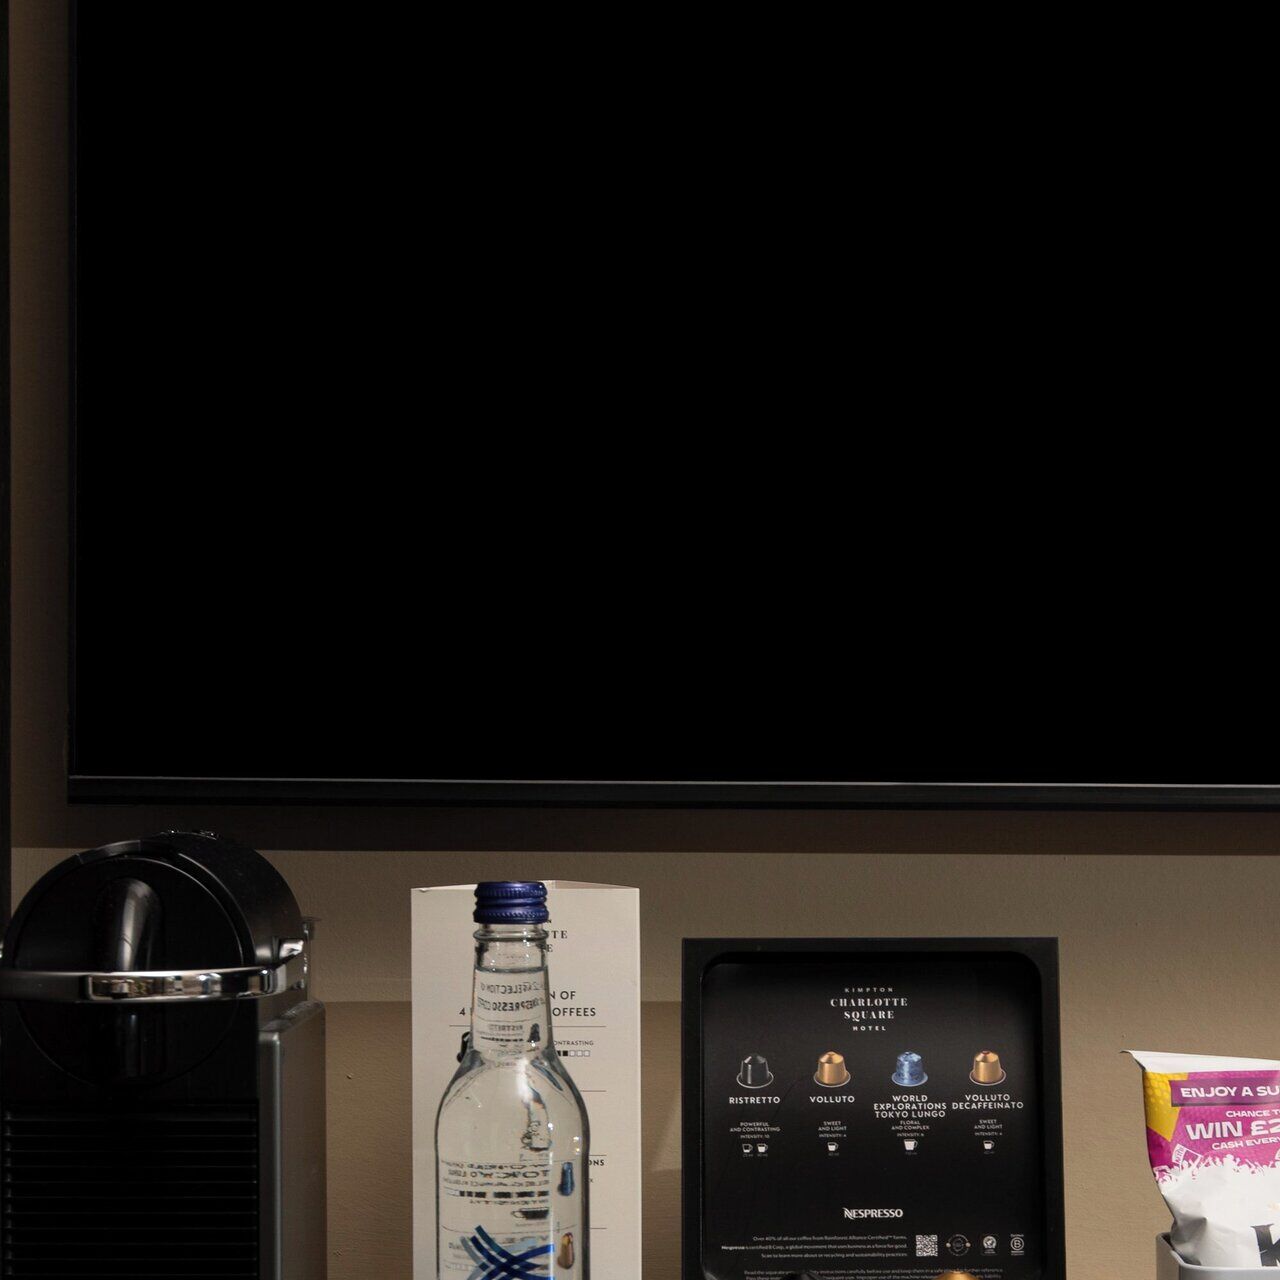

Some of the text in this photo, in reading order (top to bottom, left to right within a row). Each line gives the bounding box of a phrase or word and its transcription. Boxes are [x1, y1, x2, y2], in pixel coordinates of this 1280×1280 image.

[560, 991, 576, 1000] OF
[830, 998, 908, 1007] CHARLOTTE
[459, 1007, 596, 1017] 4 OFFEES
[844, 1010, 895, 1022] SQUARE
[1180, 1086, 1238, 1098] ENJOY
[1242, 1085, 1254, 1097] A
[729, 1096, 781, 1104] RISTRETTO
[810, 1095, 855, 1103] VOLLUTO
[892, 1094, 928, 1102] WORLD
[952, 1101, 1024, 1110] DECAFFEINATO
[912, 1110, 946, 1118] LUNGO
[1225, 1110, 1269, 1118] CHANCE
[1185, 1120, 1243, 1141] WIN
[1211, 1141, 1244, 1150] CASH
[842, 1207, 903, 1220] NESPRESSO
